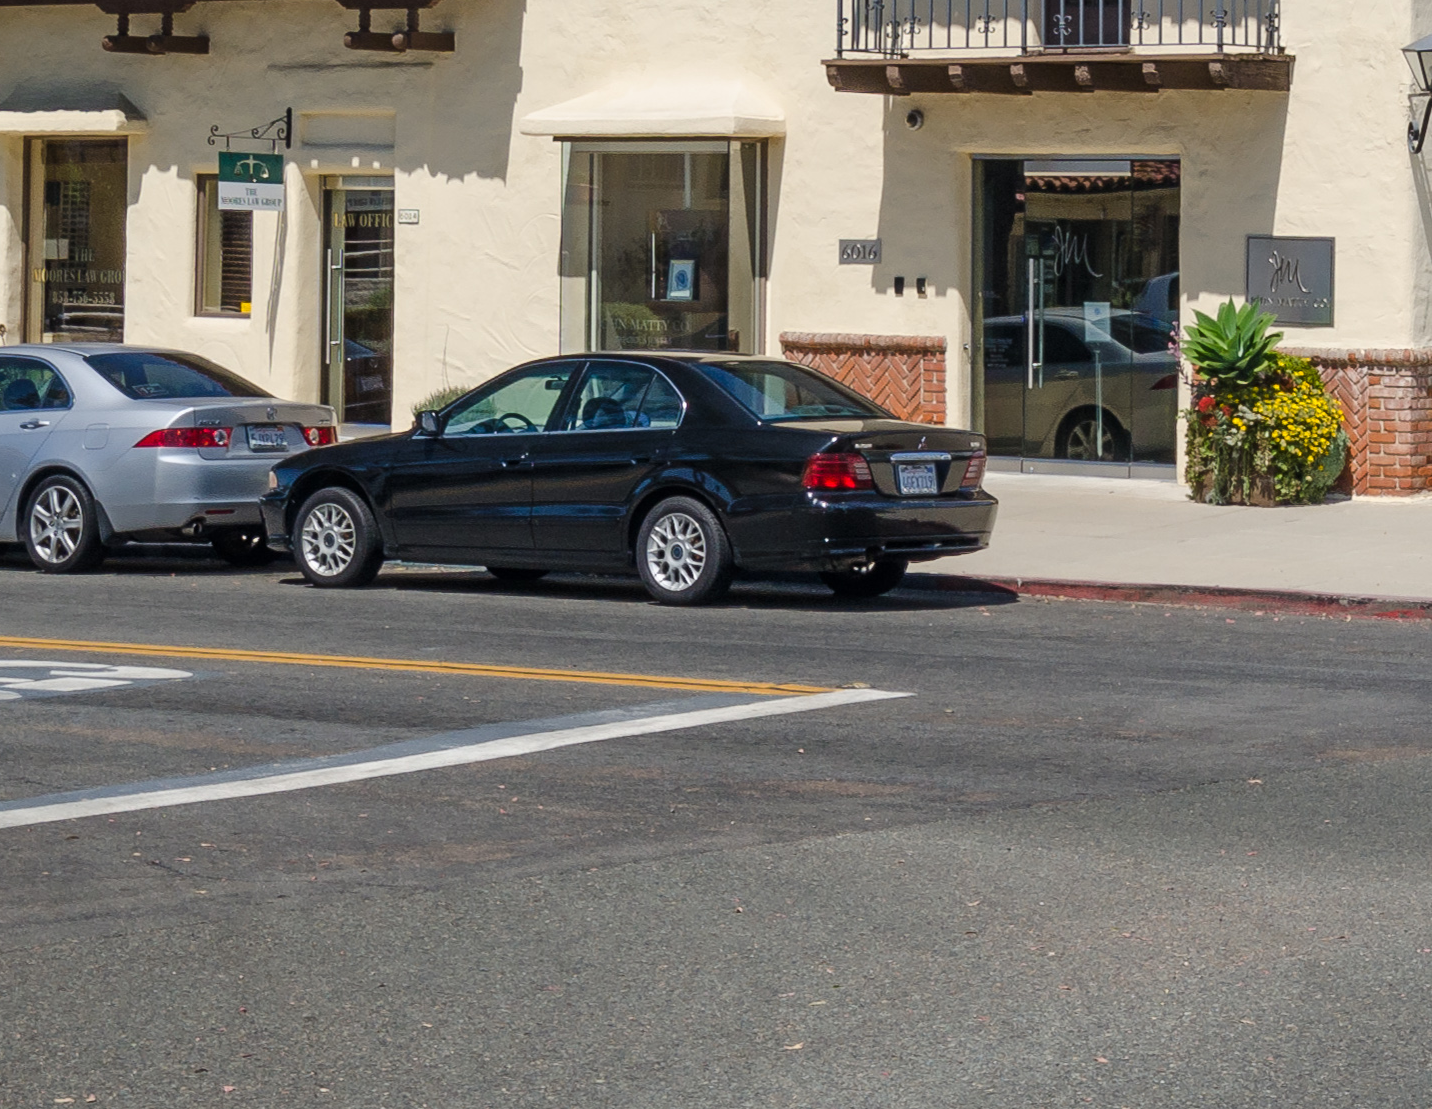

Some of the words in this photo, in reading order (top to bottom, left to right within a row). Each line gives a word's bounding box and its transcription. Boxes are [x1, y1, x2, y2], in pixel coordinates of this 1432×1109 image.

[245, 187, 258, 196] THE
[247, 197, 259, 206] LAW
[261, 197, 283, 207] GROUP
[334, 212, 356, 228] LAW
[359, 213, 393, 228] OFFIC
[75, 248, 95, 262] THE
[841, 243, 878, 260] 6016
[32, 268, 76, 283] MOORES
[77, 269, 97, 283] LAW
[630, 319, 668, 332] MATTY
